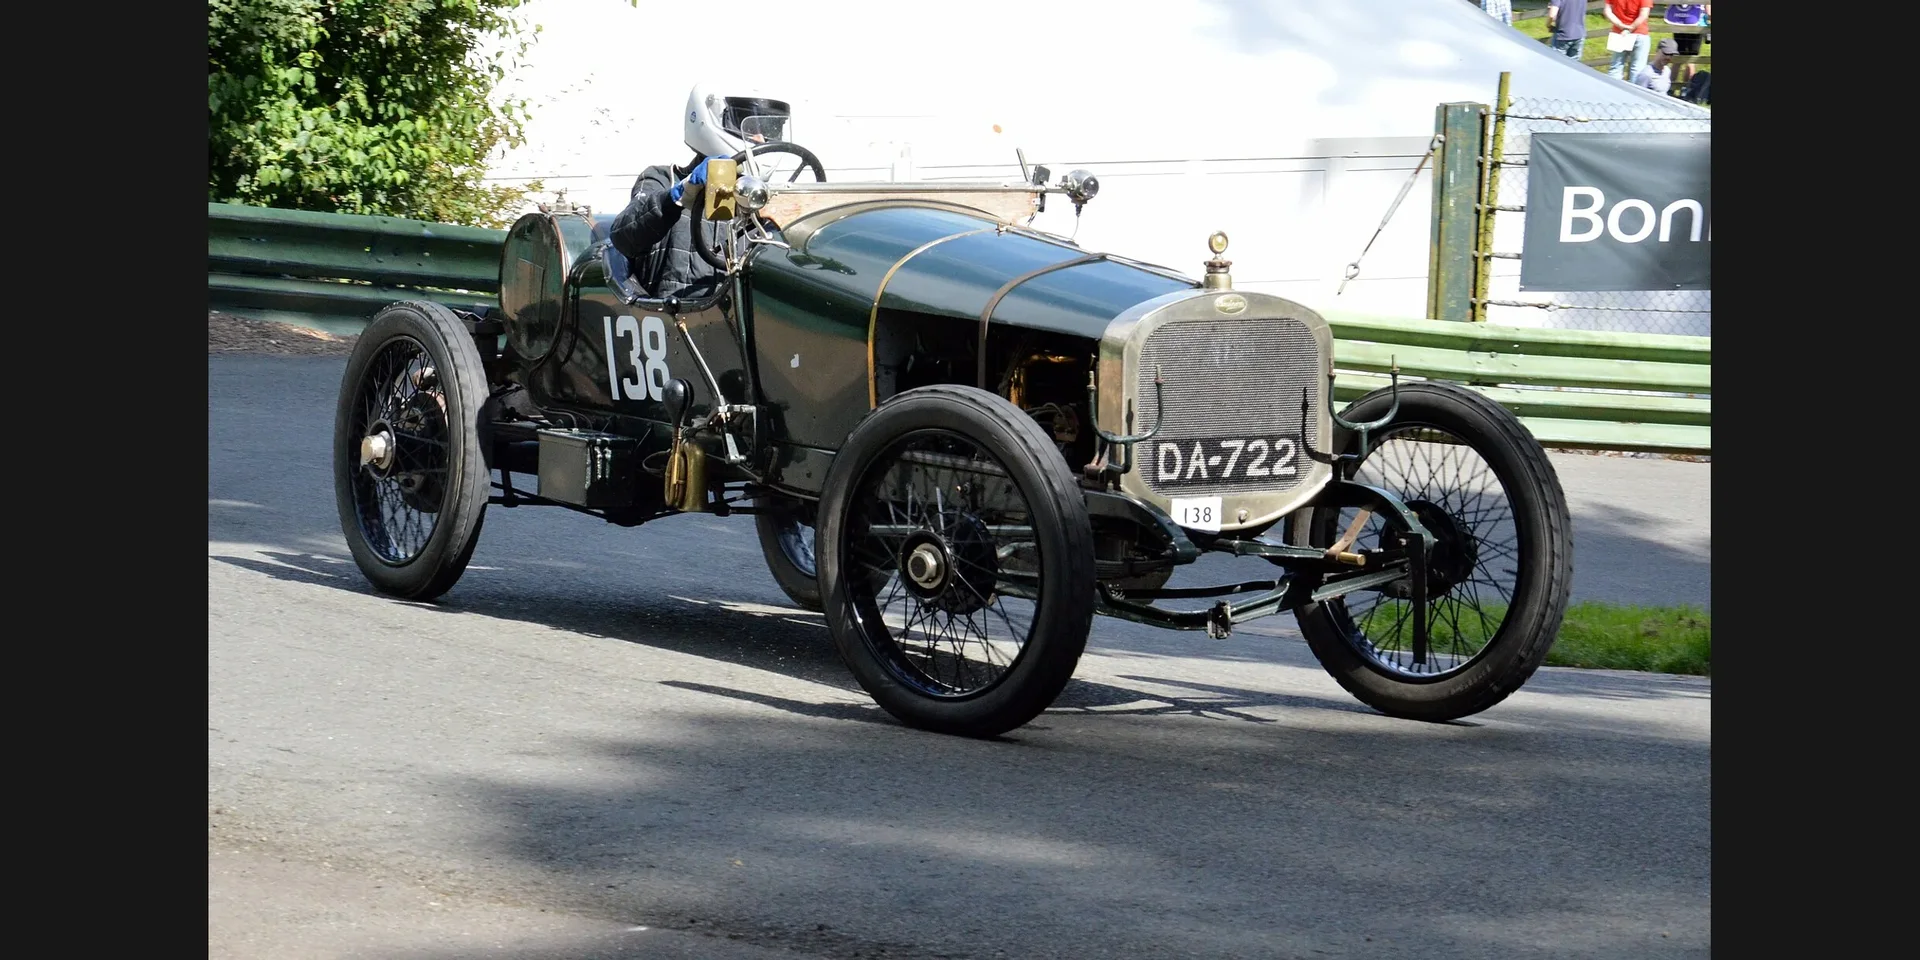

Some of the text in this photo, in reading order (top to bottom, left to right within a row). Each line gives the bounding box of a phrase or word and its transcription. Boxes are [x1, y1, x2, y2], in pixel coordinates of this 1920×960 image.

[1559, 186, 1711, 243] Bon
[604, 315, 671, 401] 138
[1157, 438, 1296, 482] DA-722
[1184, 506, 1212, 524] 138
